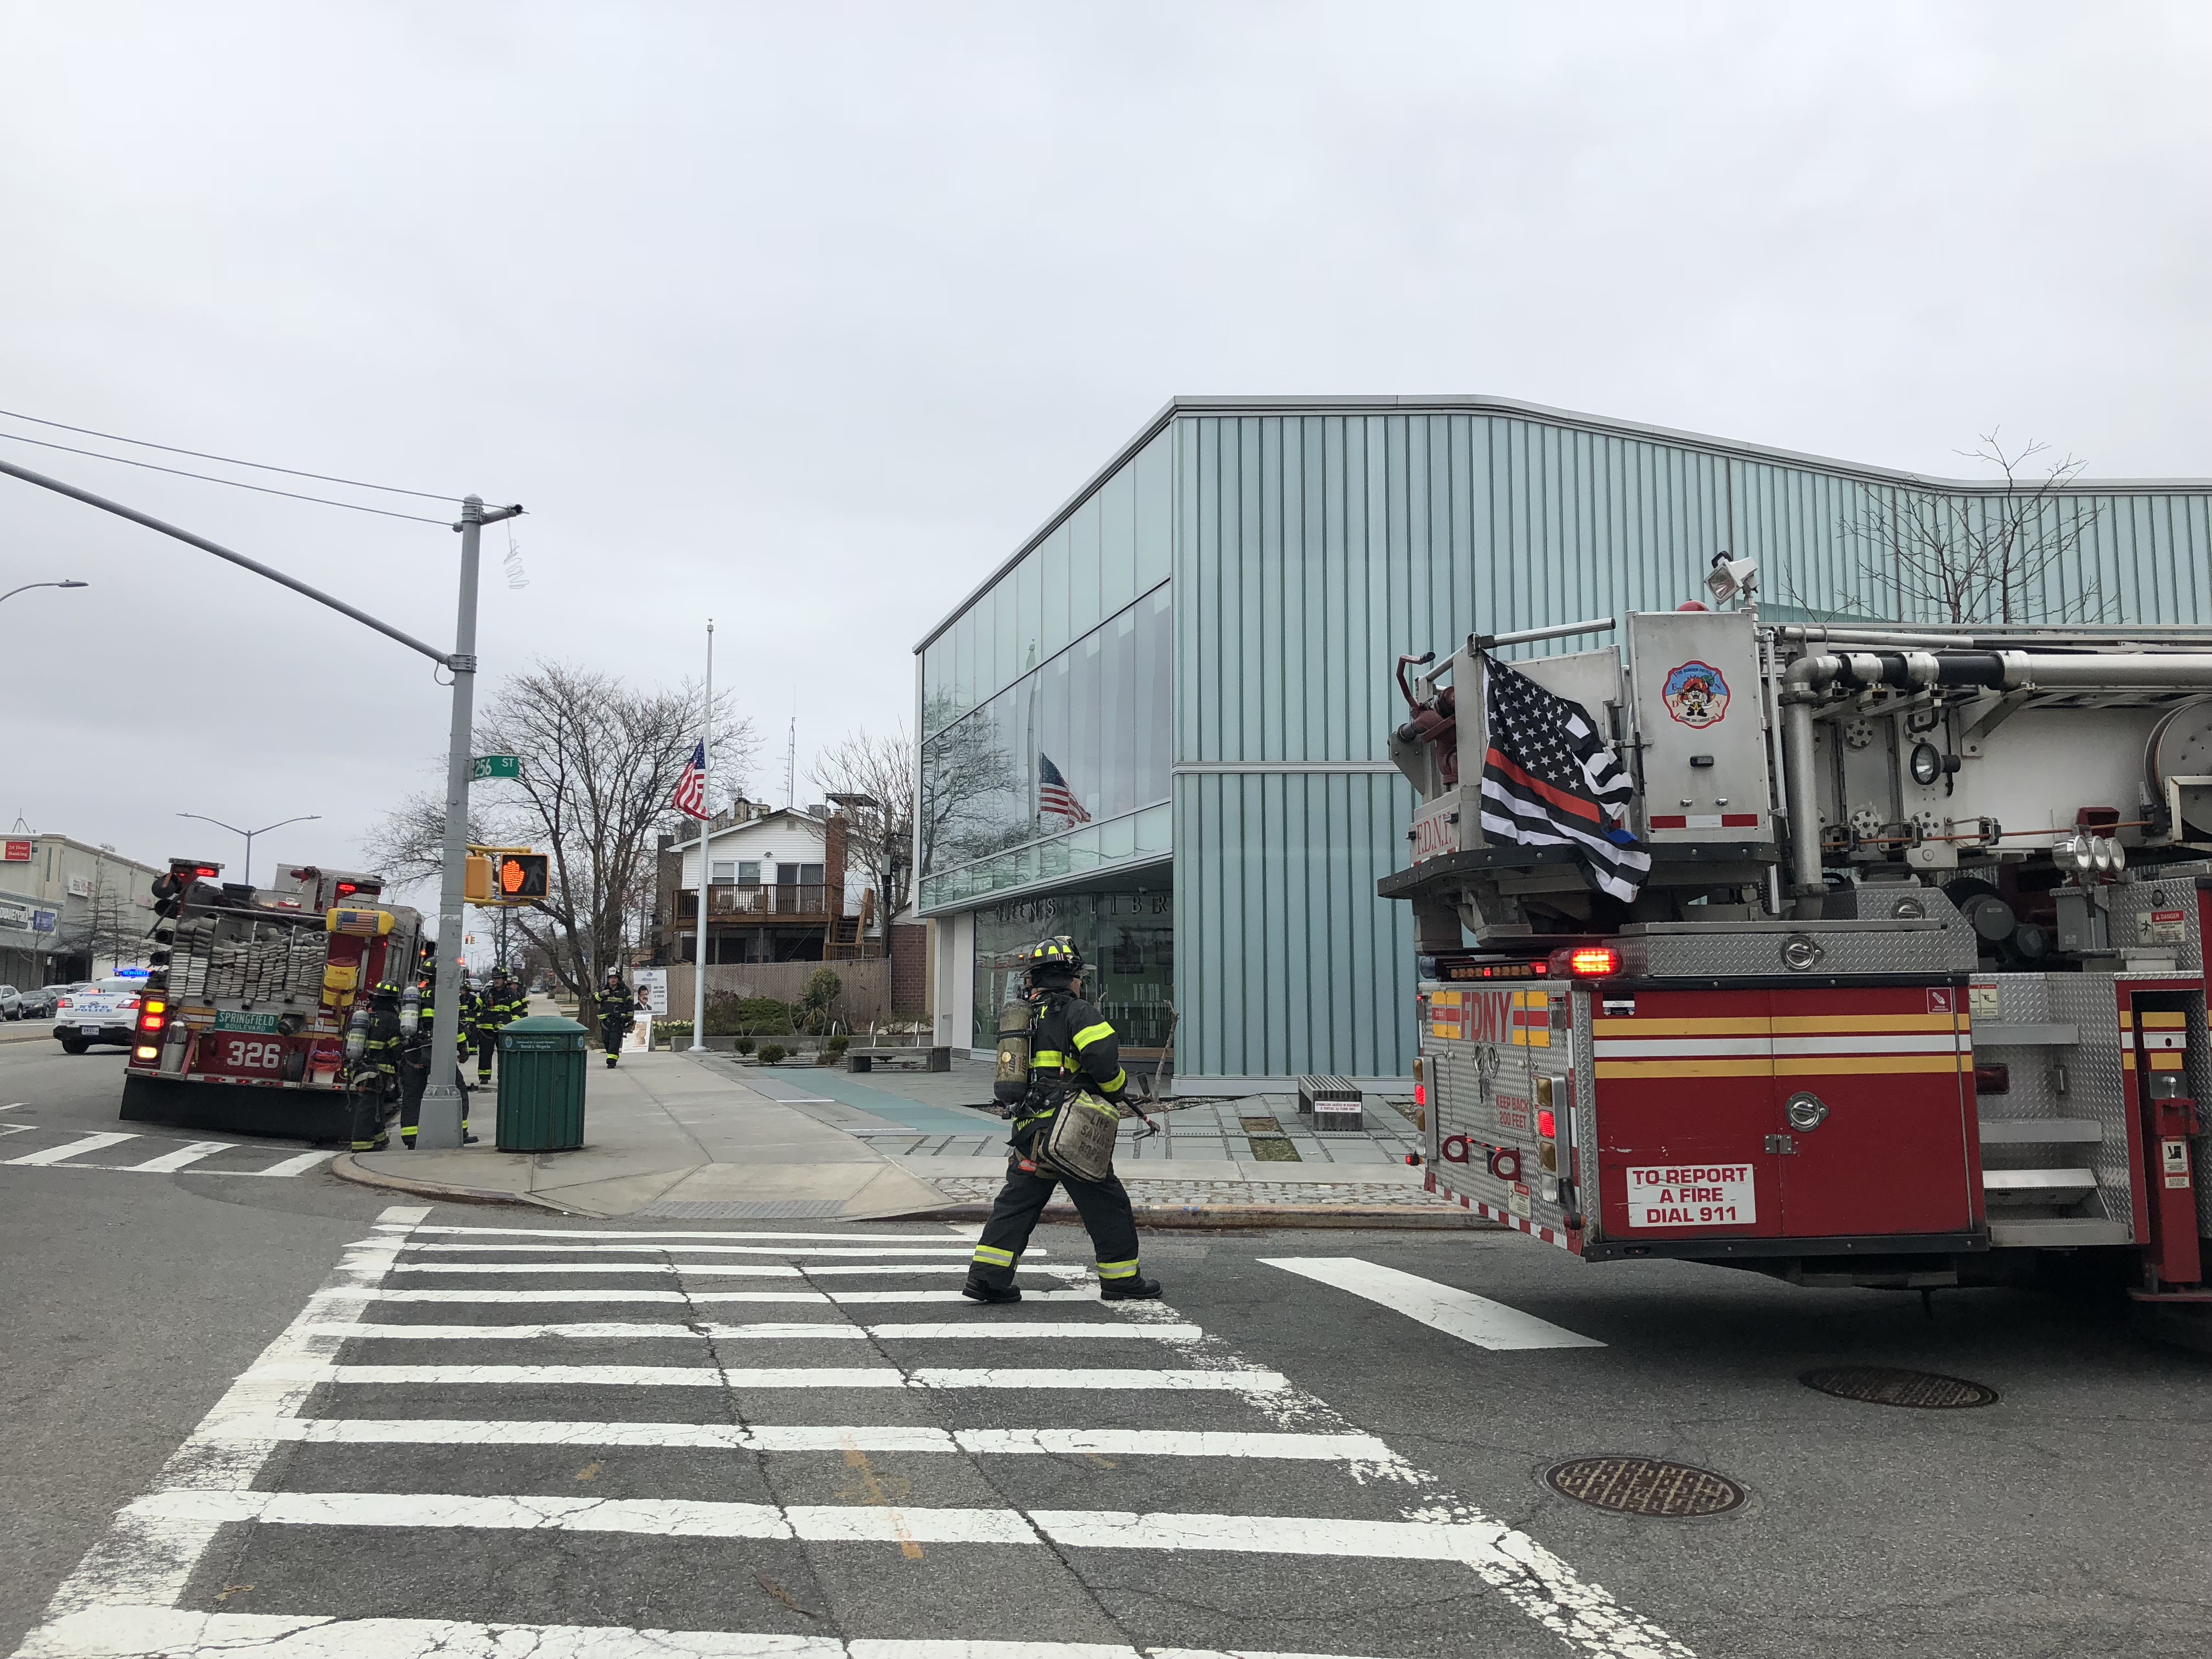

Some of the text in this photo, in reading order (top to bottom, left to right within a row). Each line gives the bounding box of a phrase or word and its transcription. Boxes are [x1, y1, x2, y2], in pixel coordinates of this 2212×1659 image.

[475, 758, 515, 777] 256 ST
[995, 898, 1056, 922] QUEENS
[219, 1012, 274, 1026] SPRINGFIELD
[1461, 991, 1512, 1043] FDNY
[225, 1023, 266, 1031] BOULEVARD
[227, 1041, 280, 1068] 326
[1496, 1095, 1529, 1113] KEEP BACK
[1090, 1114, 1110, 1132] LIFE
[1499, 1110, 1526, 1129] 200 FEET
[1080, 1124, 1110, 1149] SAVING
[1632, 1167, 1747, 1185] TO REPORT
[1660, 1187, 1723, 1204] A FIRE
[1646, 1206, 1736, 1223] DIAL 911
